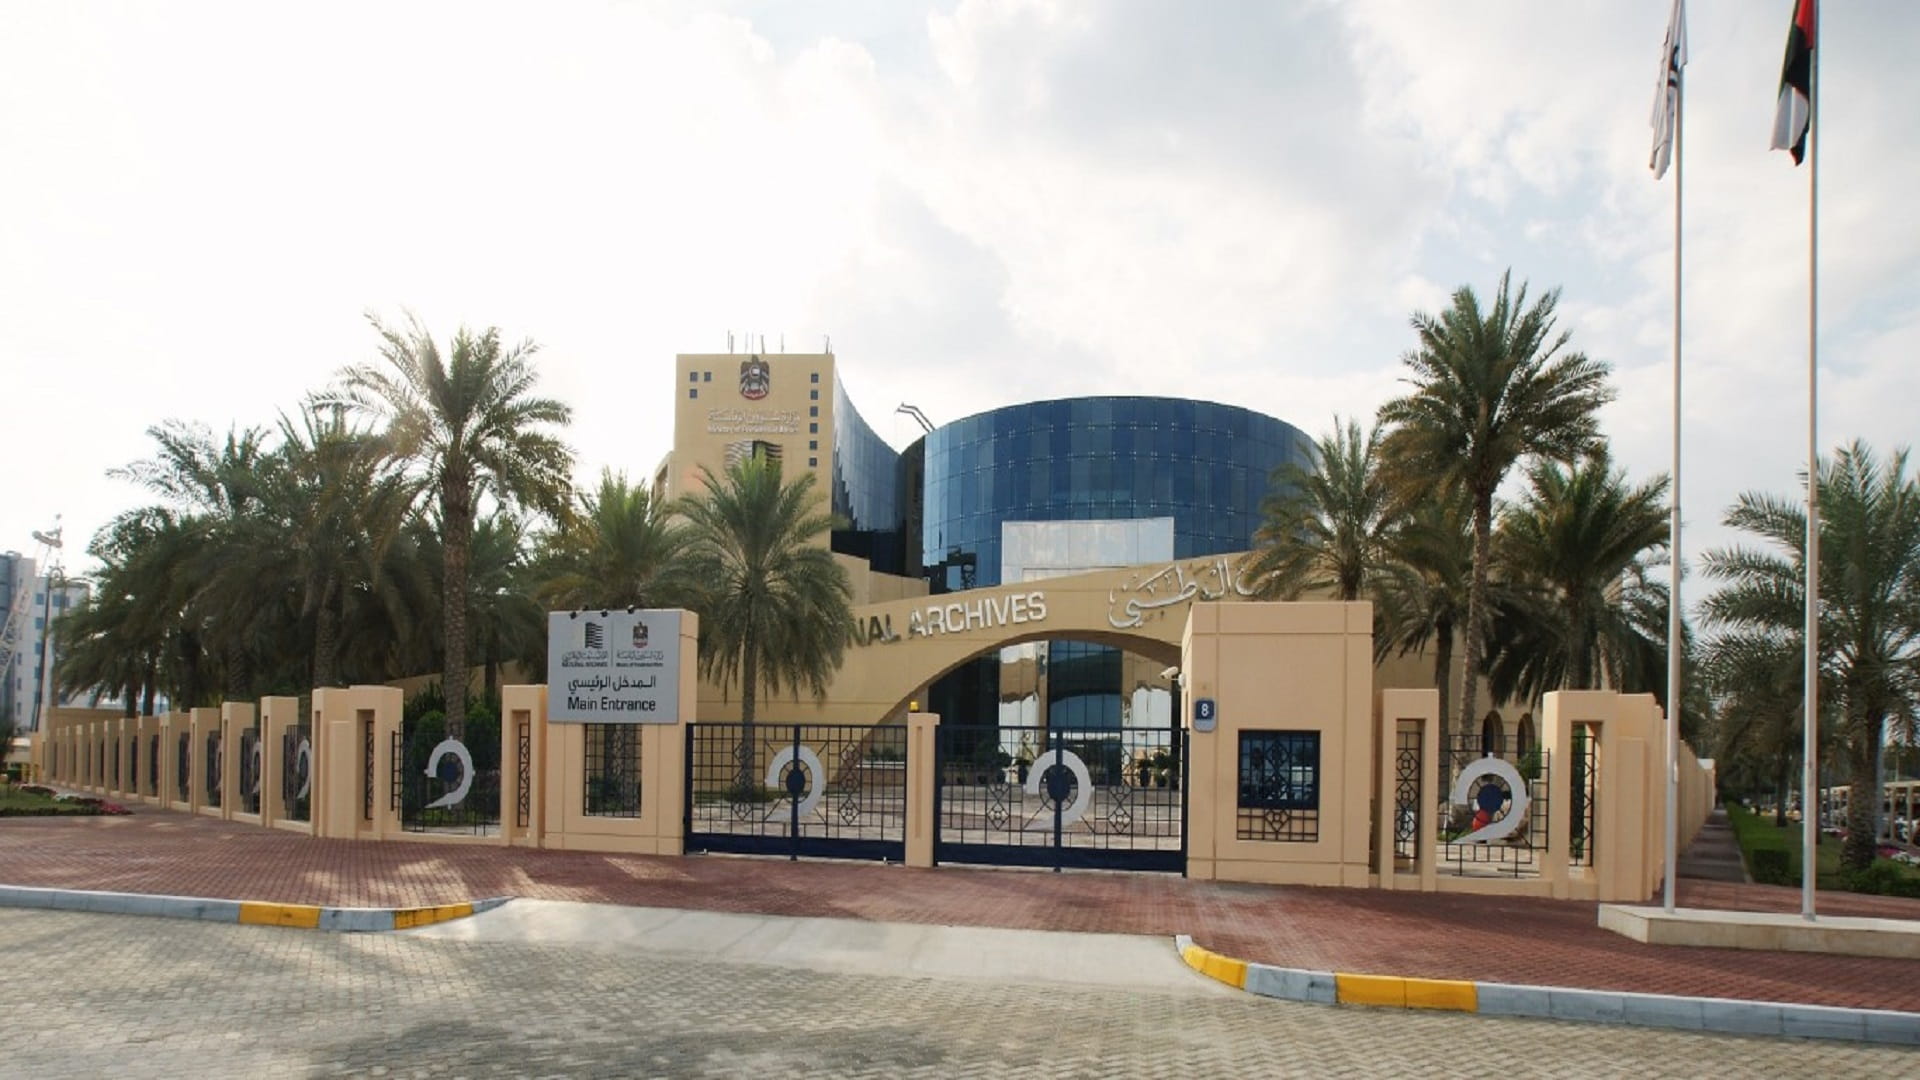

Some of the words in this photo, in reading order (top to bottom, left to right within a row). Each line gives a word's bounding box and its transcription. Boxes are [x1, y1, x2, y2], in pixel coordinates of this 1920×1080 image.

[909, 591, 1047, 638] ARCHIVES
[568, 675, 611, 694] الرئيسي
[612, 675, 656, 692] المدخل
[567, 696, 598, 711] Main
[601, 696, 656, 712] Entrance
[1201, 703, 1209, 717] 8
